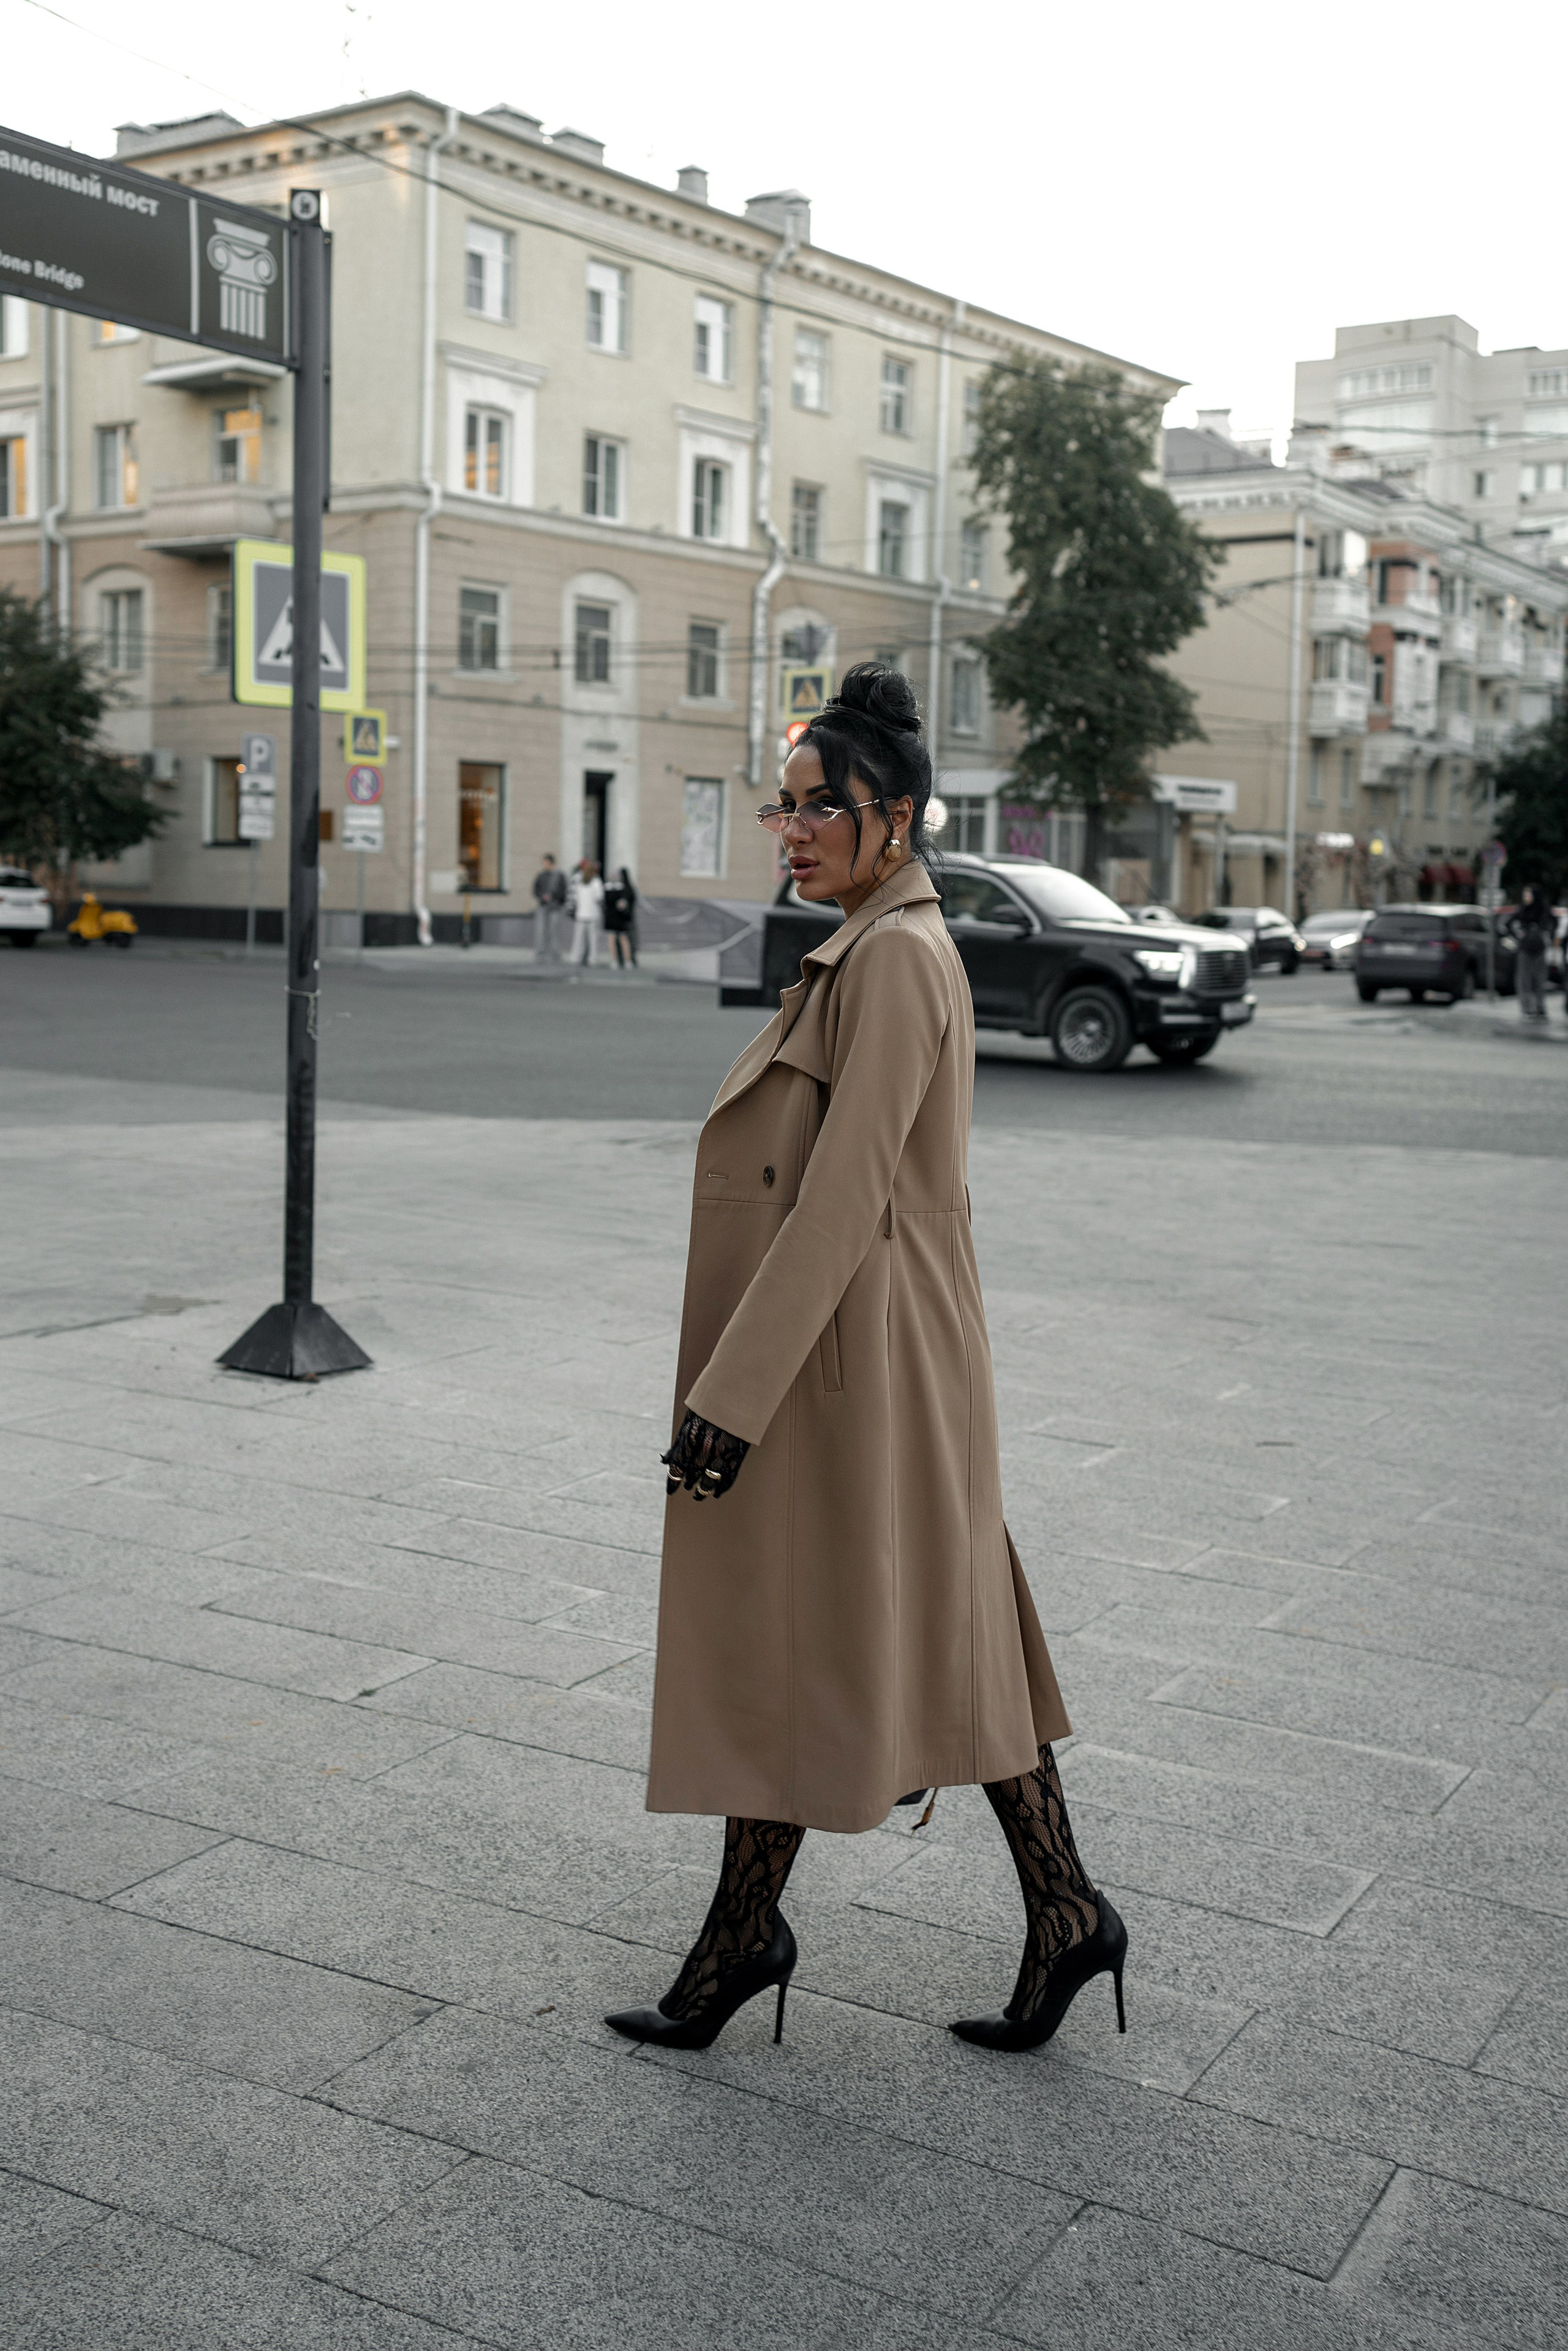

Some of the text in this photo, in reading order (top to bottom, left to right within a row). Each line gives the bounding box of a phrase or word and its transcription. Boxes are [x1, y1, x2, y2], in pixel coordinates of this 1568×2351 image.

[107, 185, 160, 217] мост
[0, 250, 85, 290] one Bridge
[250, 738, 270, 770] P
